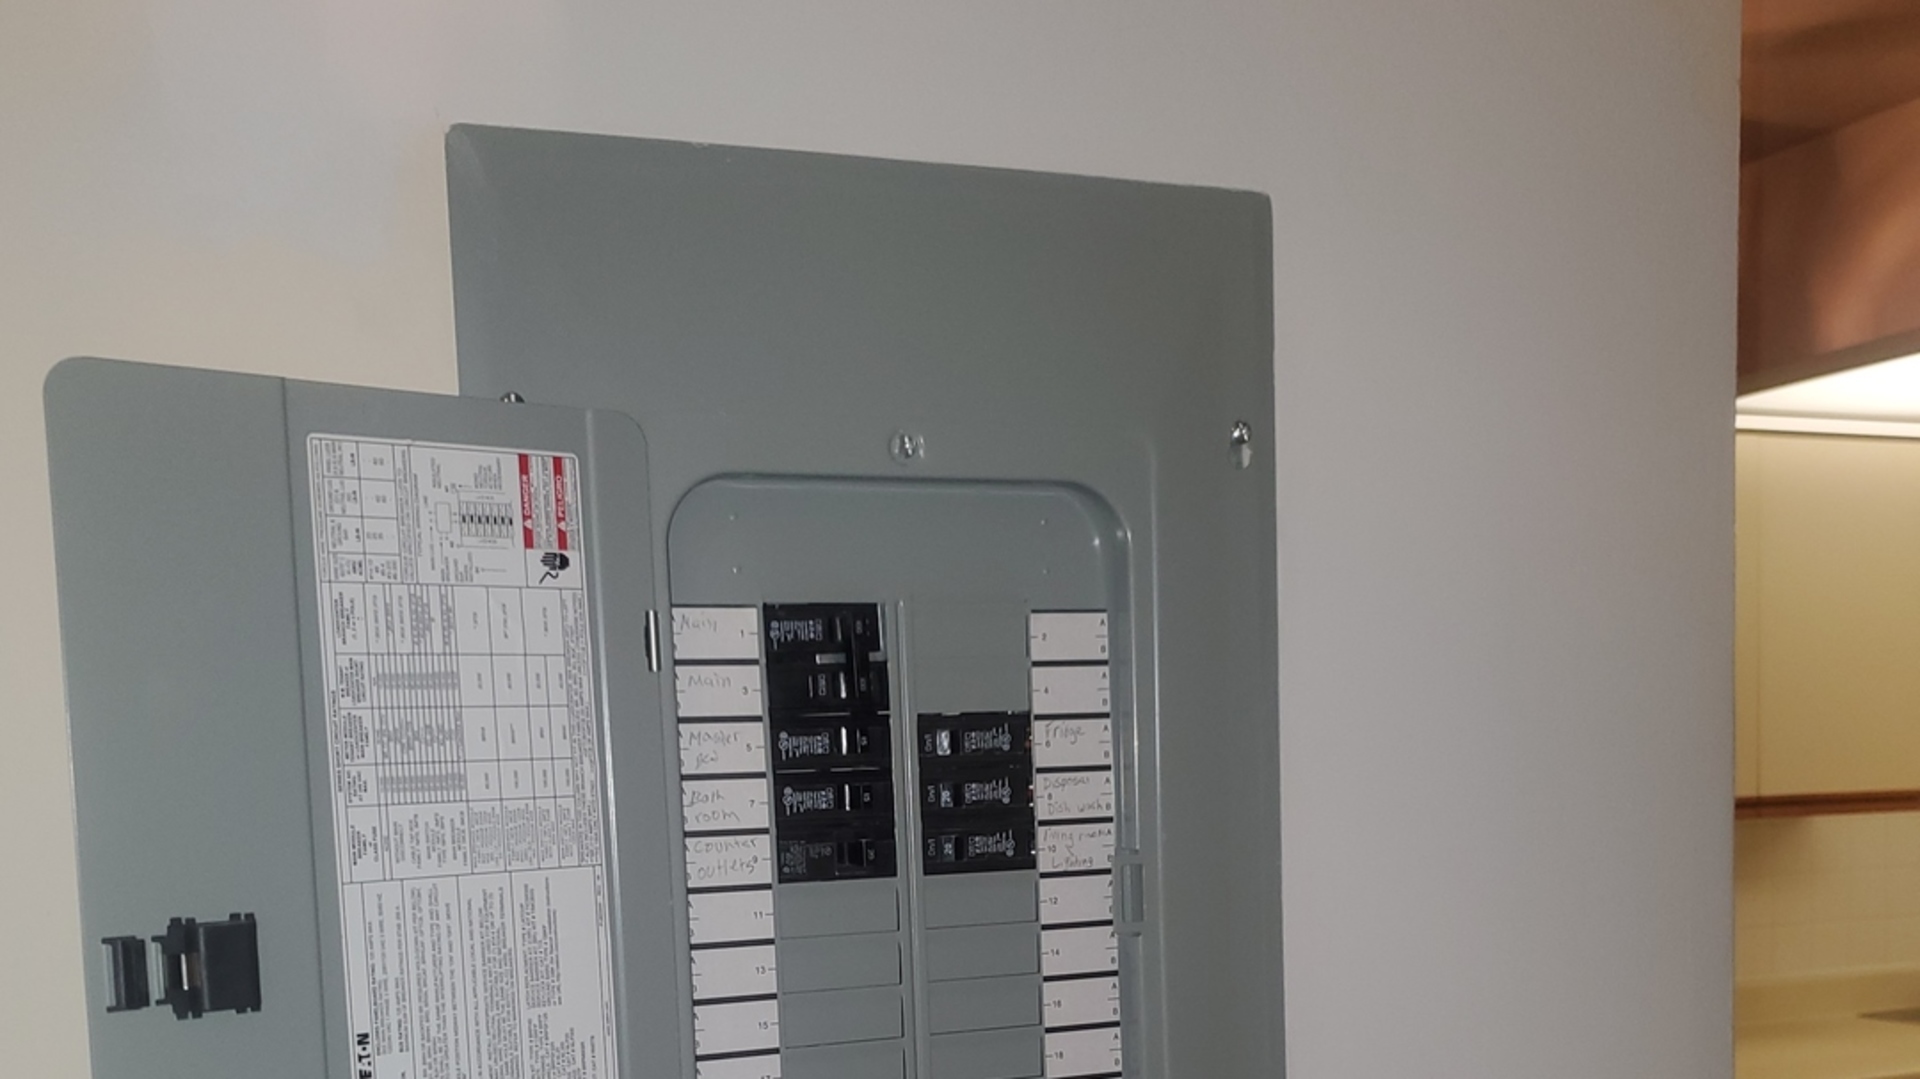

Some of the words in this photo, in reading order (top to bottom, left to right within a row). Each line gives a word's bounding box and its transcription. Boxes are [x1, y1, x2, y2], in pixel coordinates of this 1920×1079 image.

[522, 474, 531, 516] DANGER
[556, 474, 565, 518] PELIGRO
[688, 672, 731, 688] Main
[1049, 896, 1058, 905] 12
[753, 911, 763, 919] 11
[755, 966, 767, 975] 13
[1052, 1000, 1062, 1008] 16
[758, 1021, 769, 1030] 15
[1054, 1051, 1064, 1059] 18
